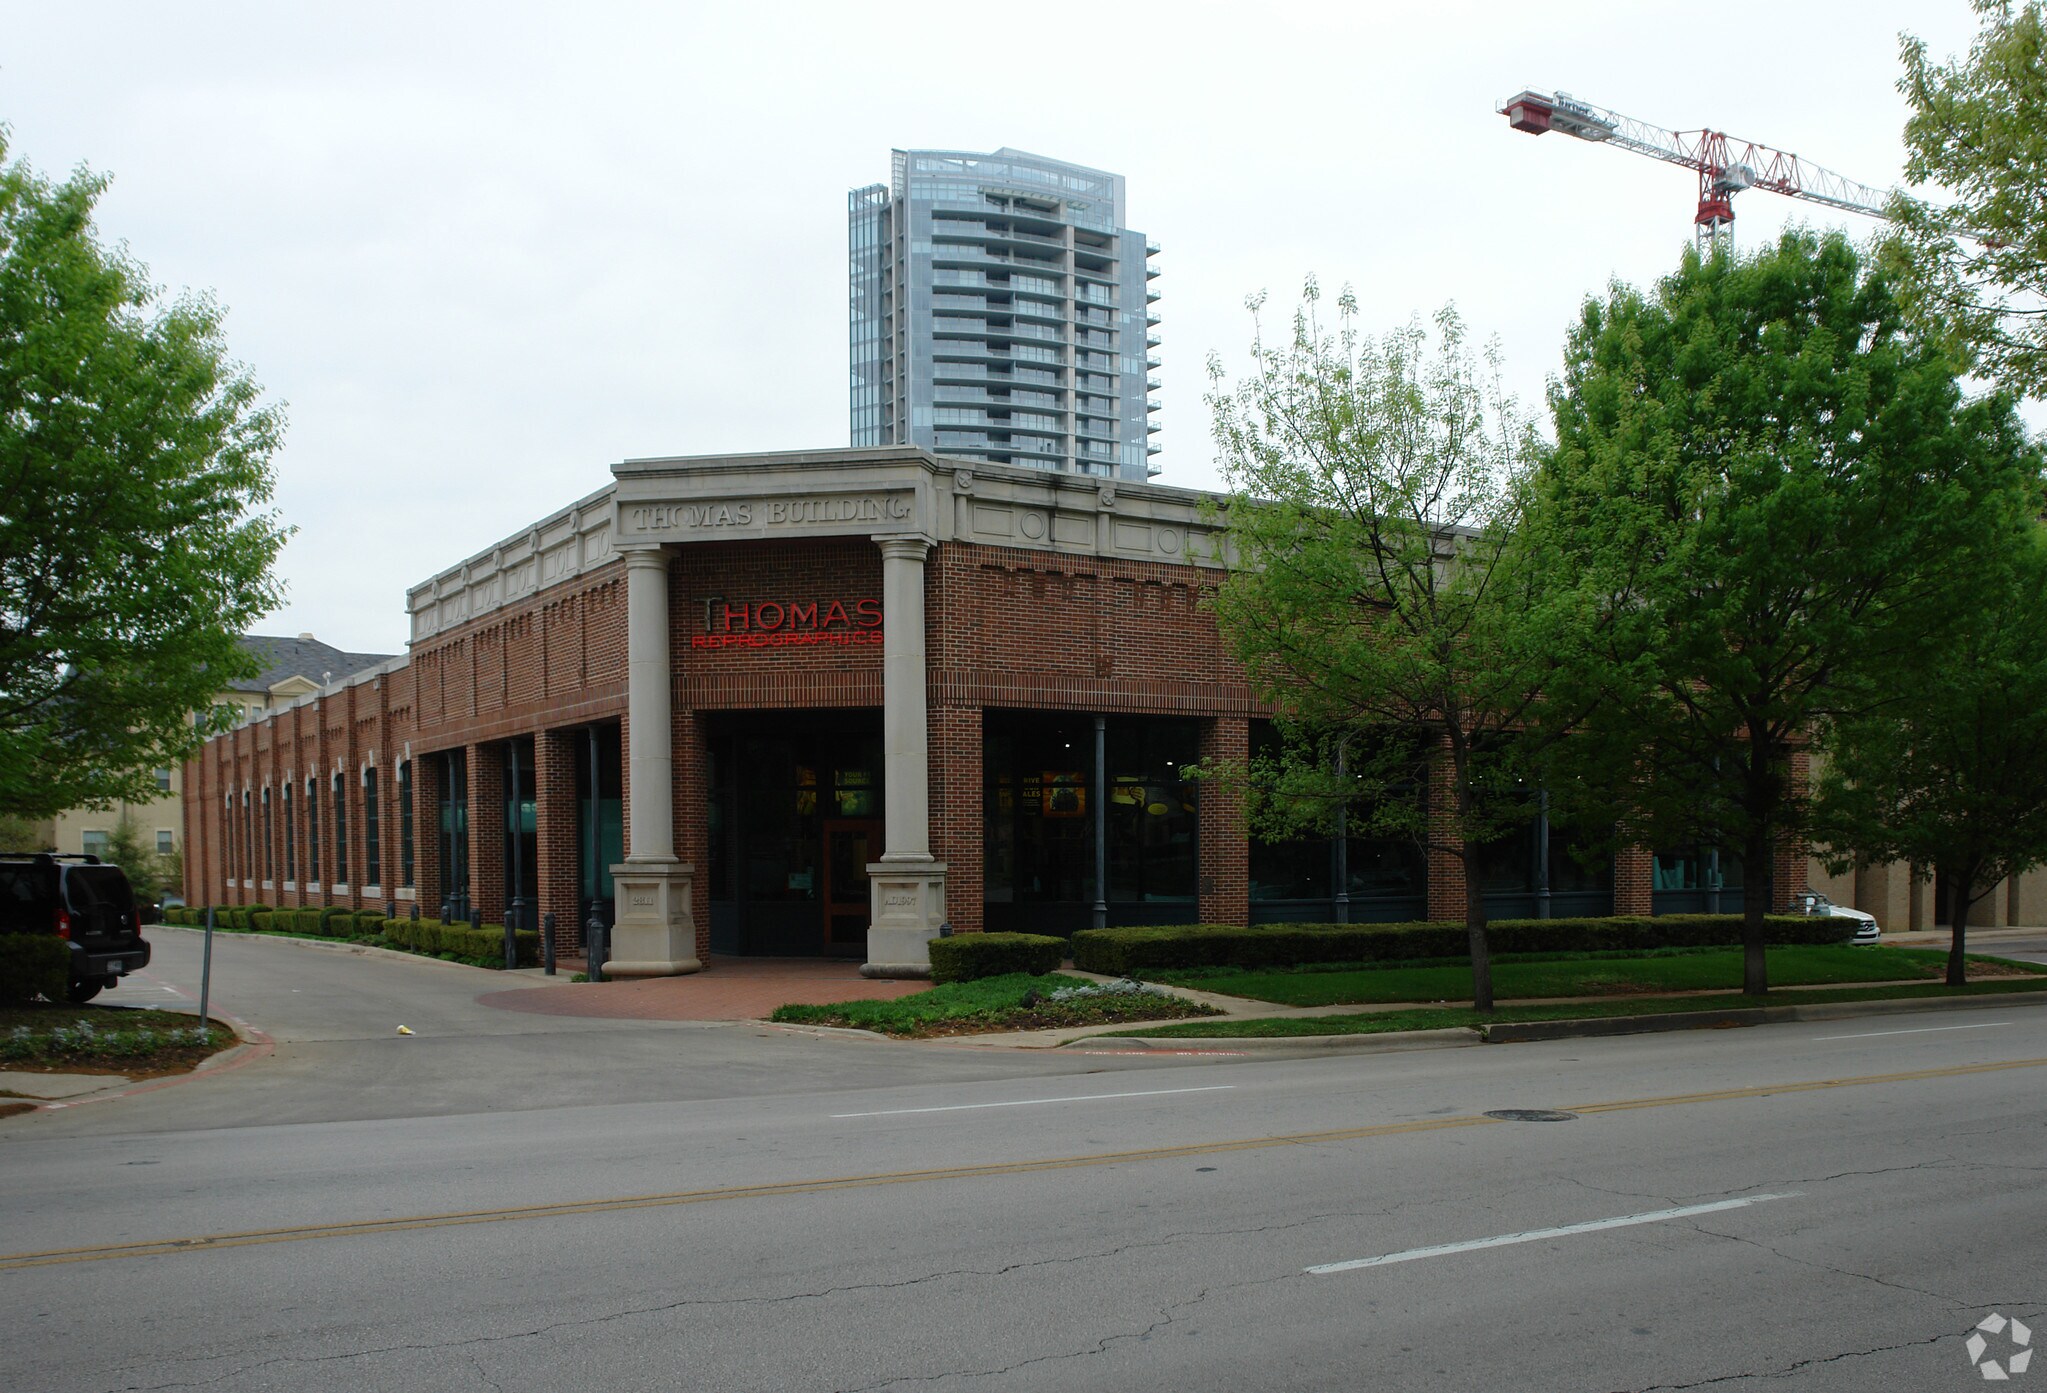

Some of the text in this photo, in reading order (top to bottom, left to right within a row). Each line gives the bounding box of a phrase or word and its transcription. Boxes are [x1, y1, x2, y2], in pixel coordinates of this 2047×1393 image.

[633, 497, 910, 530] THOMAS BUILDING
[693, 596, 884, 632] THOMAS
[692, 631, 884, 648] REPROGRAPHICS
